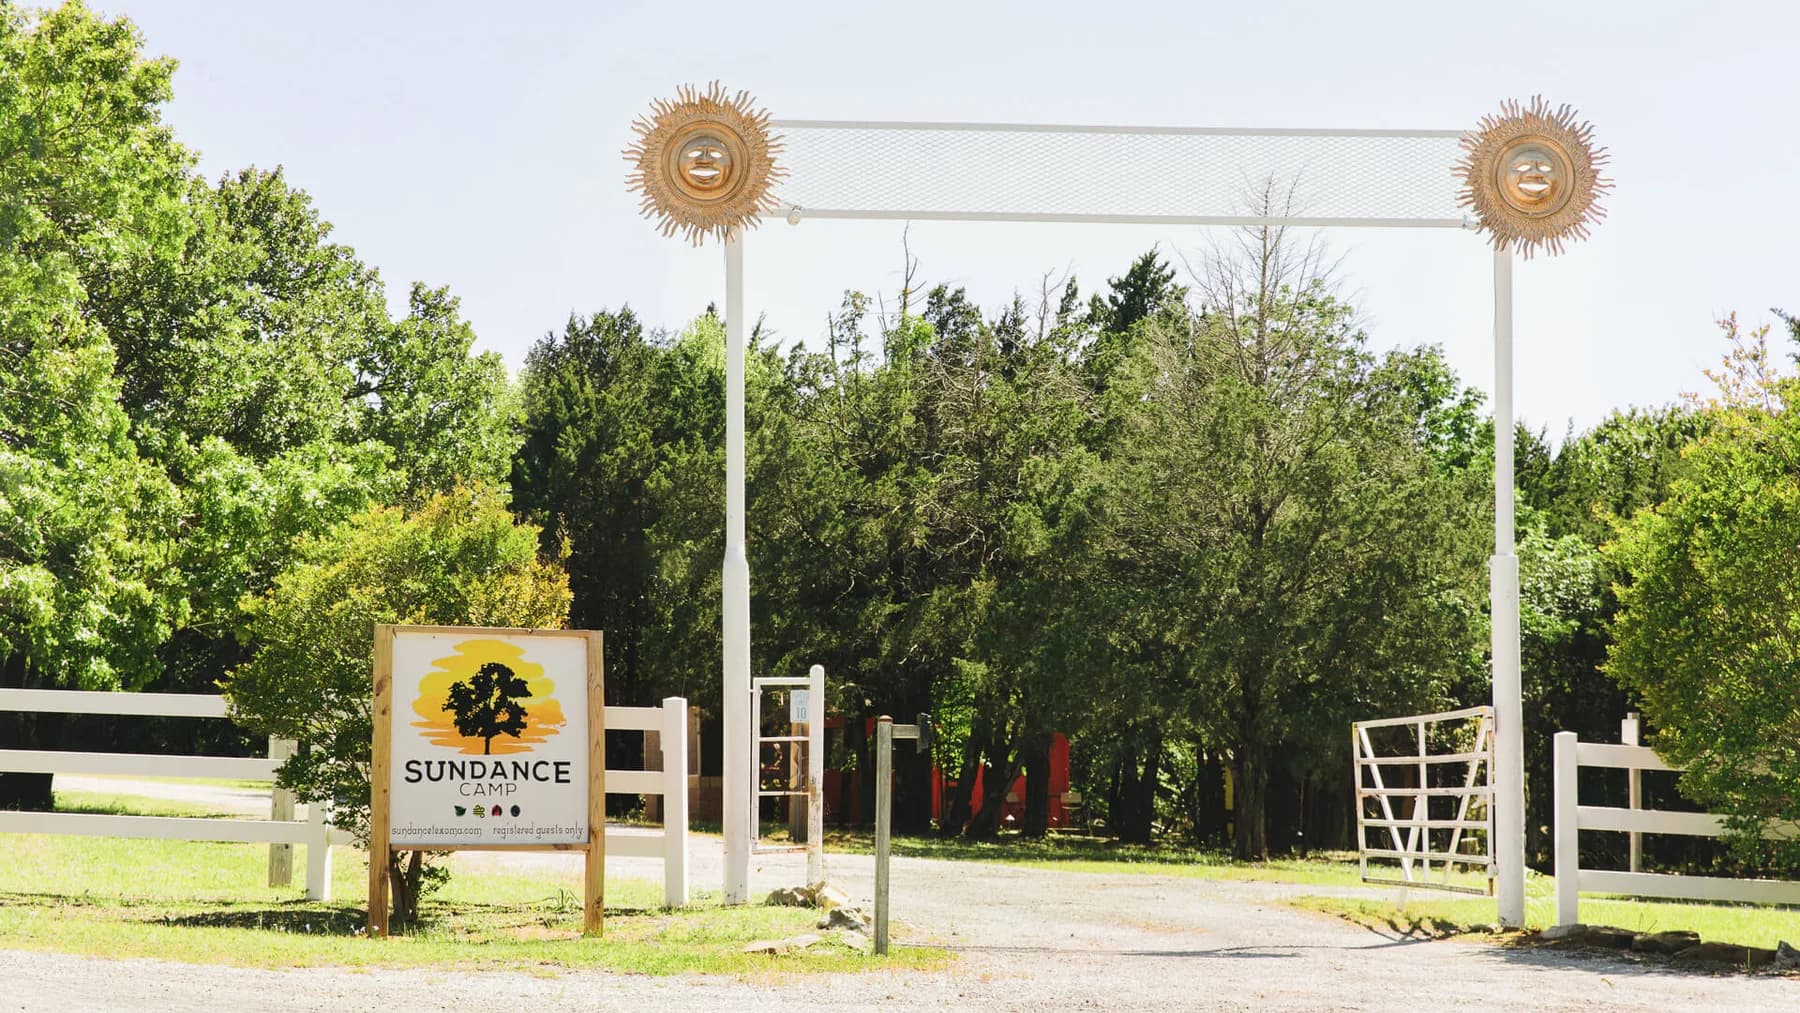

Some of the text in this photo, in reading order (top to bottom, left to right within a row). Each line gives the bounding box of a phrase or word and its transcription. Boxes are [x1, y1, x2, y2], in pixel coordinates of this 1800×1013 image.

[796, 706, 807, 719] 10
[404, 760, 571, 784] SUNDANCE
[459, 782, 517, 797] CAMP
[391, 821, 482, 838] sundancetexoma.com
[493, 820, 584, 839] registered guests only
